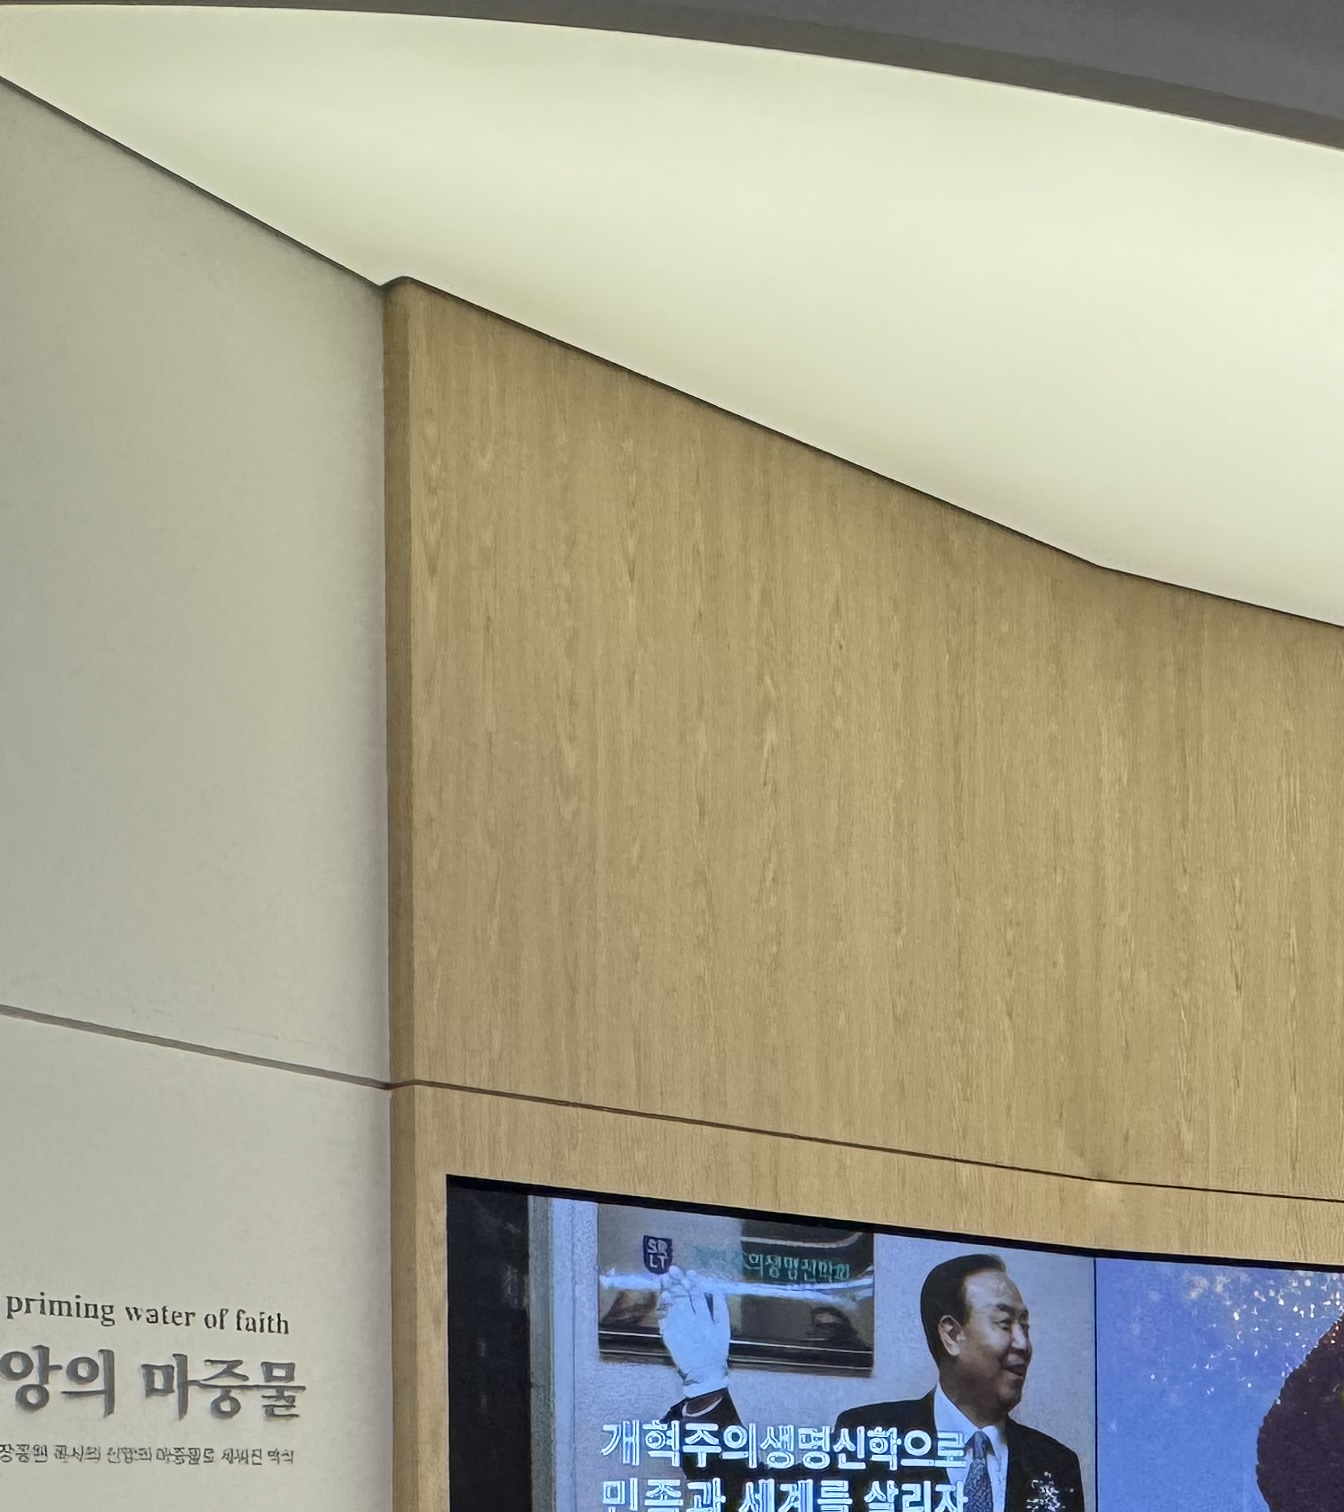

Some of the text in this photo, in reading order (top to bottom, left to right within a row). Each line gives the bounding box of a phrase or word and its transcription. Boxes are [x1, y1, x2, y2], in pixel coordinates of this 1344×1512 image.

[6, 1291, 290, 1334] priming water of faith
[0, 1344, 307, 1420] 앙의 마중물
[600, 1419, 968, 1471] 개혁주의생명신학으로
